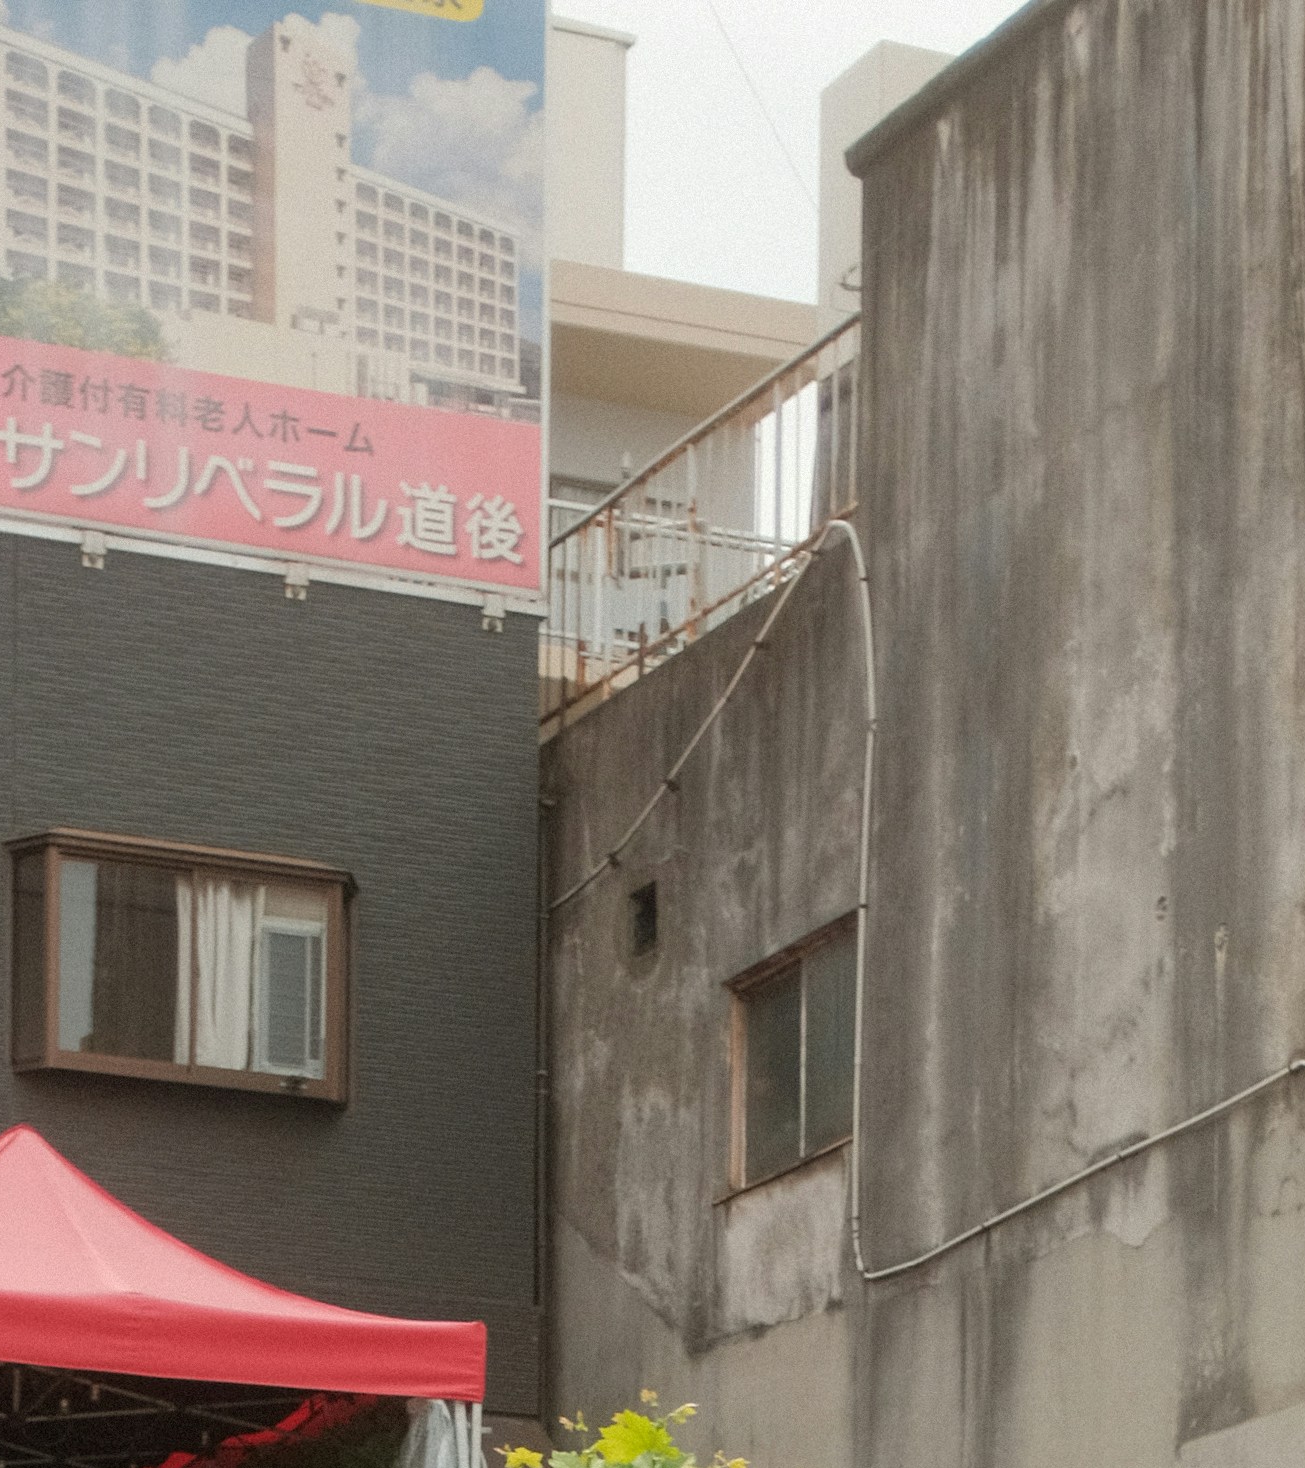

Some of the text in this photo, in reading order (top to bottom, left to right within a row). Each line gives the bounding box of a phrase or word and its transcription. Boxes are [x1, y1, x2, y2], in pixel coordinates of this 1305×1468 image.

[0, 364, 375, 455] 介護付有料老人ホーム
